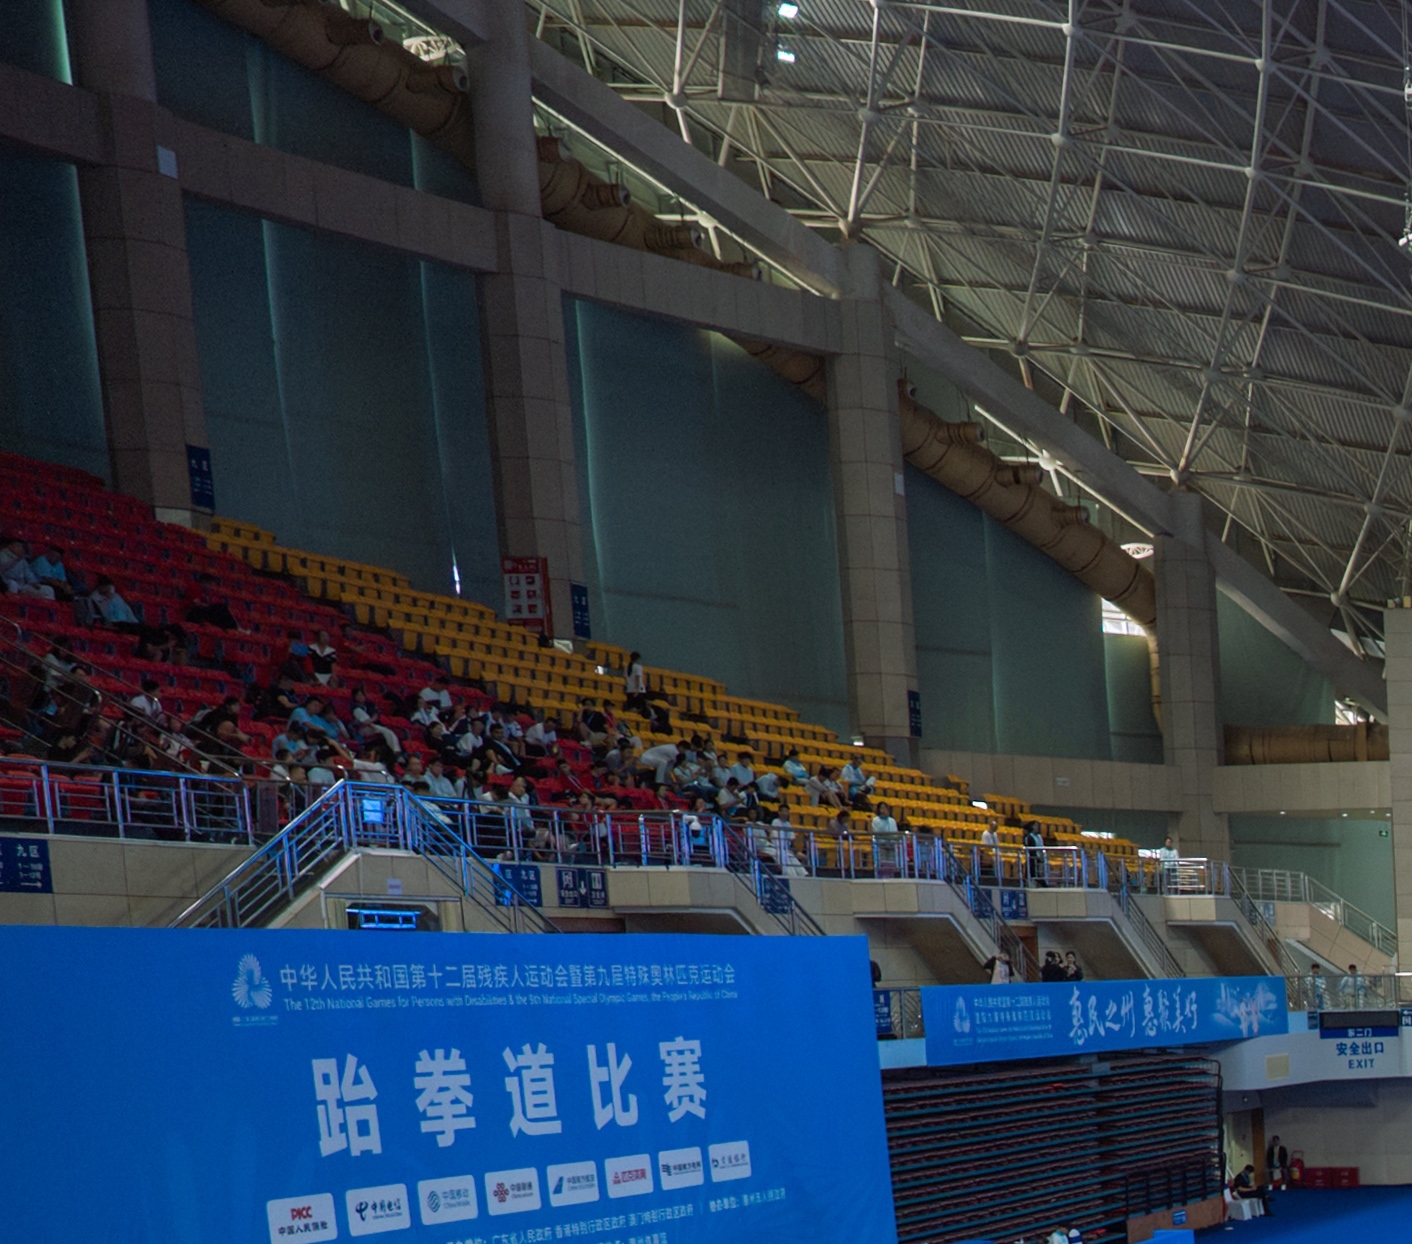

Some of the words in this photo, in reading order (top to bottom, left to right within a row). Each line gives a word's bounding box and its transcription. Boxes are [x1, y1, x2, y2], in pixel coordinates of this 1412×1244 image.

[280, 963, 735, 992] 中华人民共和国第十二届残疾人运动会暨第九届特殊奥林匹克运动会
[327, 997, 364, 1009] National
[366, 997, 396, 1008] Games
[411, 996, 445, 1007] Persons
[1336, 1042, 1384, 1057] 安全出口
[1348, 1058, 1375, 1069] EXIT
[311, 1036, 708, 1157] 跆拳道比赛
[291, 1206, 313, 1221] PICC
